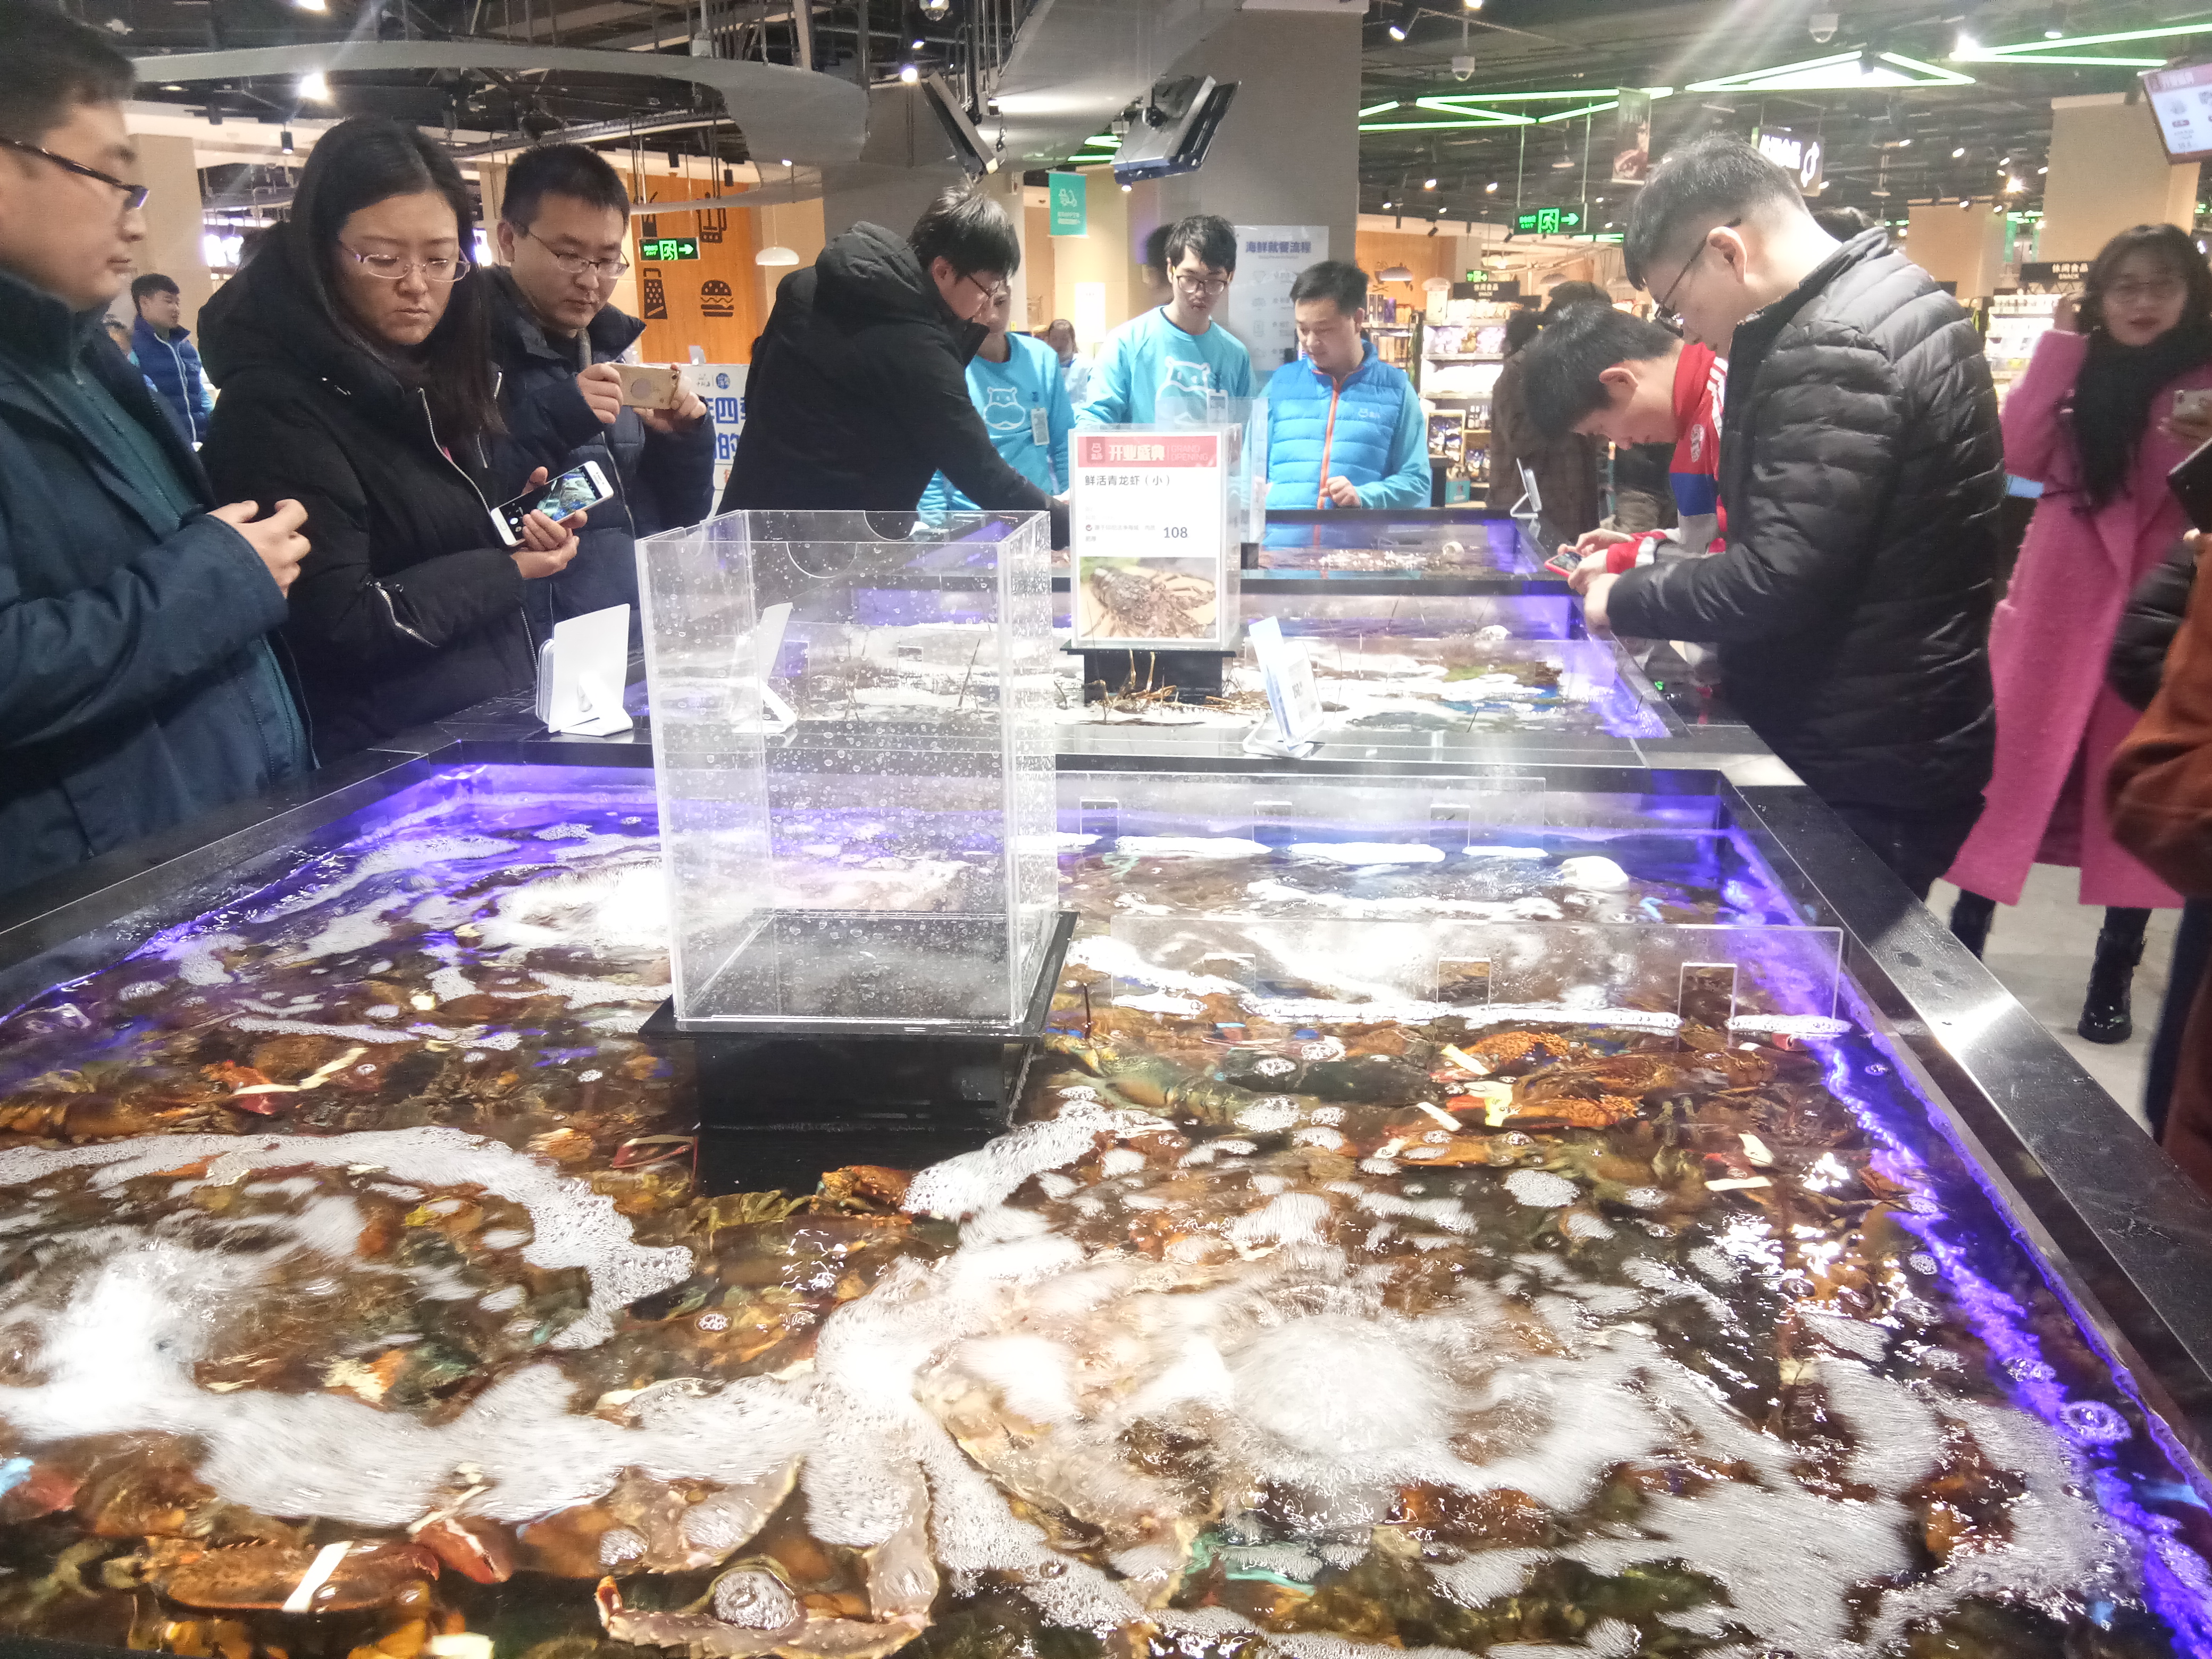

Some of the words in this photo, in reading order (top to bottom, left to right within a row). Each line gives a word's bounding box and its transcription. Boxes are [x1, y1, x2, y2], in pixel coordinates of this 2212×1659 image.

[1109, 445, 1165, 462] 开业盛典
[1171, 453, 1209, 462] OPENING
[1163, 527, 1188, 538] 108
